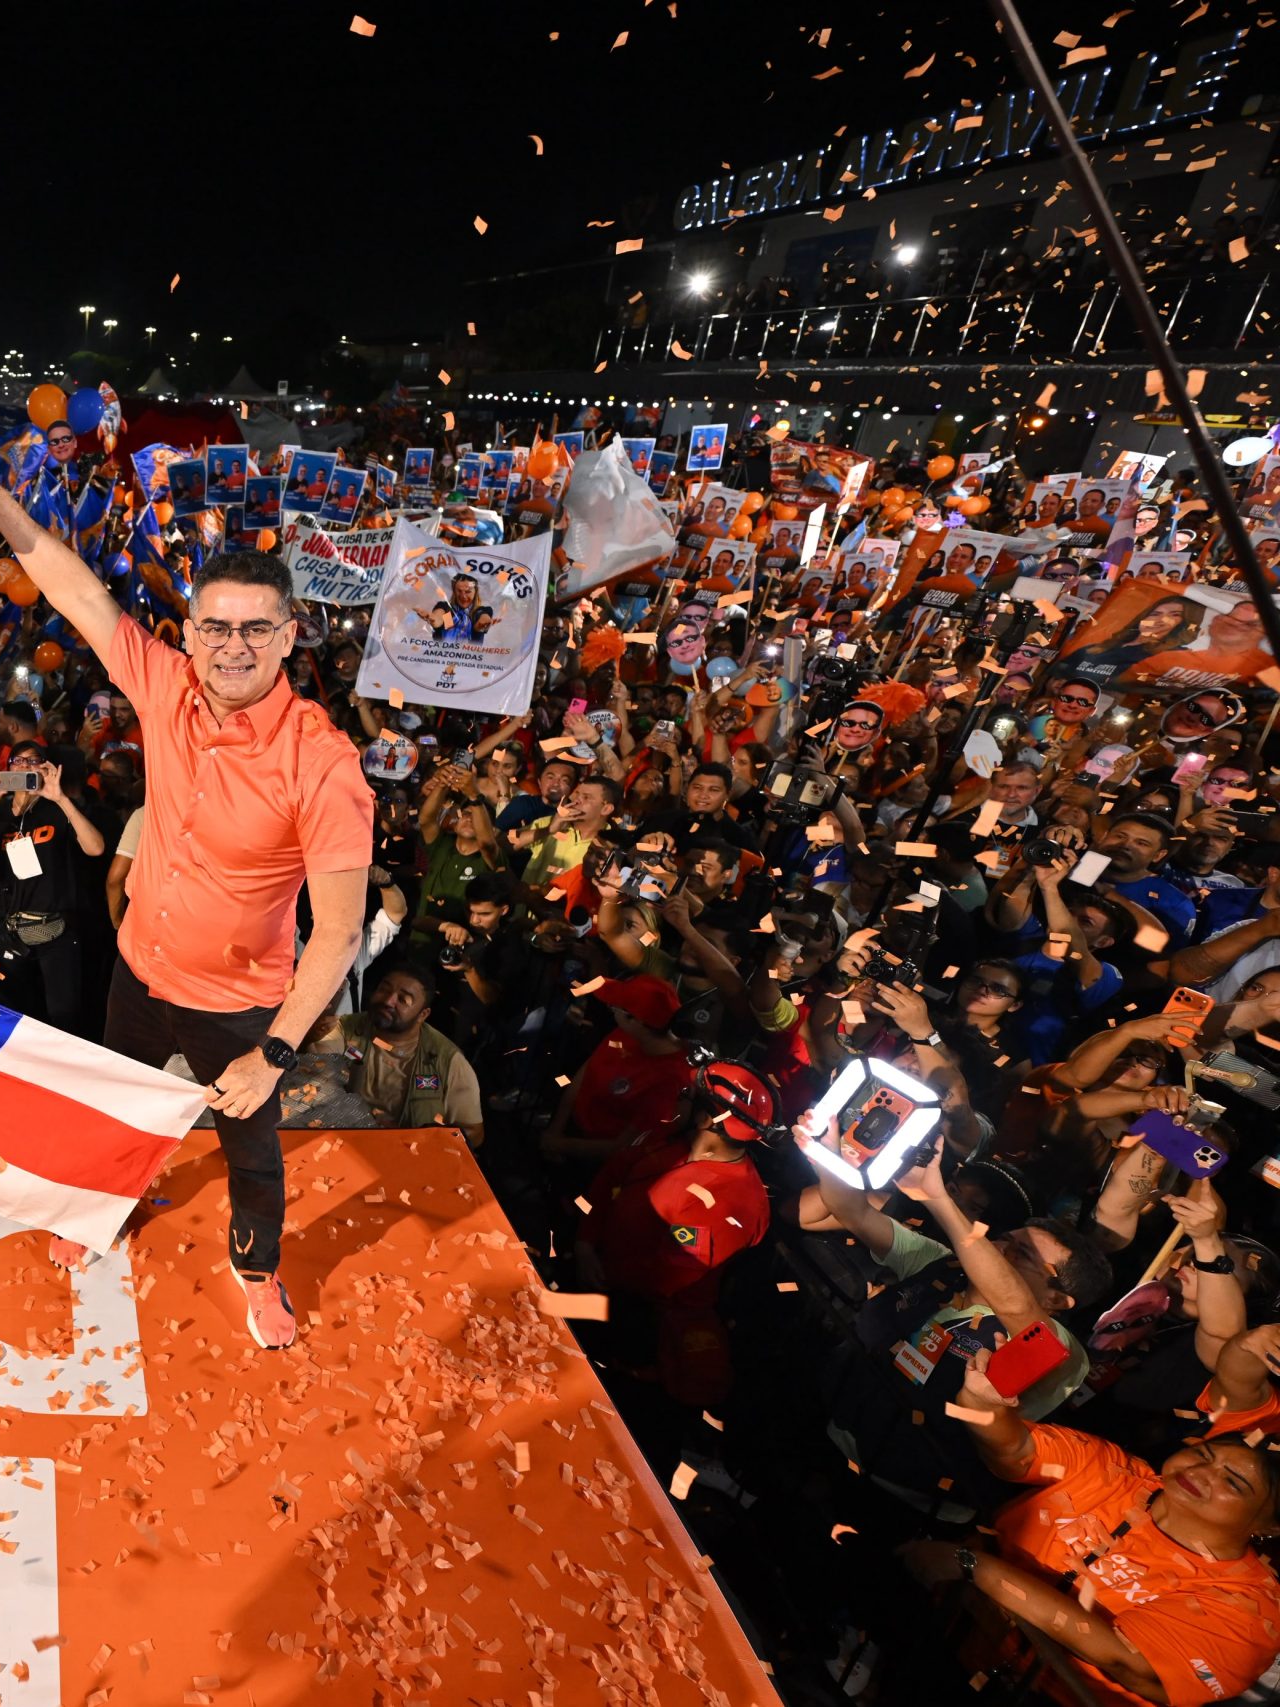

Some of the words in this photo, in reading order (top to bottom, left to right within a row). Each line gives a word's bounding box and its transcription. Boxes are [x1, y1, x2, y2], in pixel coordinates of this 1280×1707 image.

[673, 148, 824, 231] GALERIA
[295, 556, 342, 578] CASA
[409, 638, 440, 650] FORÇA
[442, 642, 461, 650] DAS
[462, 644, 511, 656] MULHERES
[423, 650, 484, 662] AMAZONIDAS
[435, 681, 457, 689] PDT
[901, 1349, 929, 1377] IMPRENSA
[1190, 1658, 1225, 1699] AVANTE
